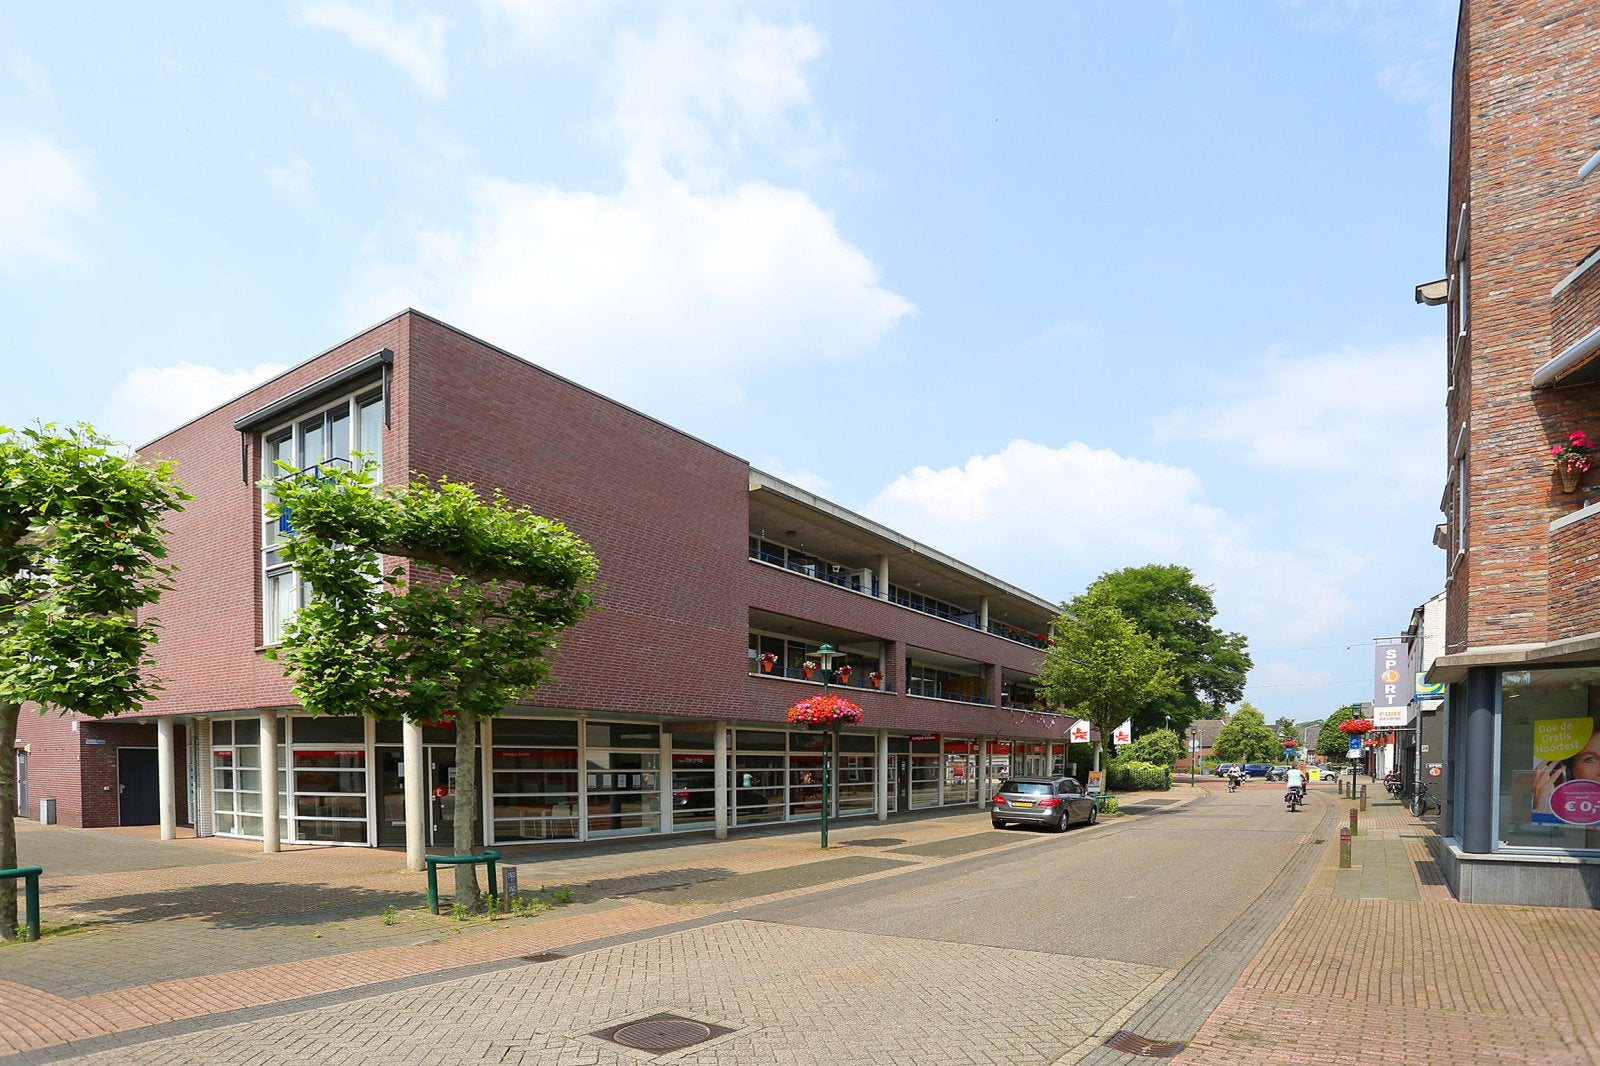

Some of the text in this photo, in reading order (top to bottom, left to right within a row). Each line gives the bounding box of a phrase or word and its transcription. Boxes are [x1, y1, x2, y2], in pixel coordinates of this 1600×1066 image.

[1539, 721, 1573, 733] Doe de
[1542, 732, 1571, 743] Gratis
[1536, 741, 1579, 753] Hoortest
